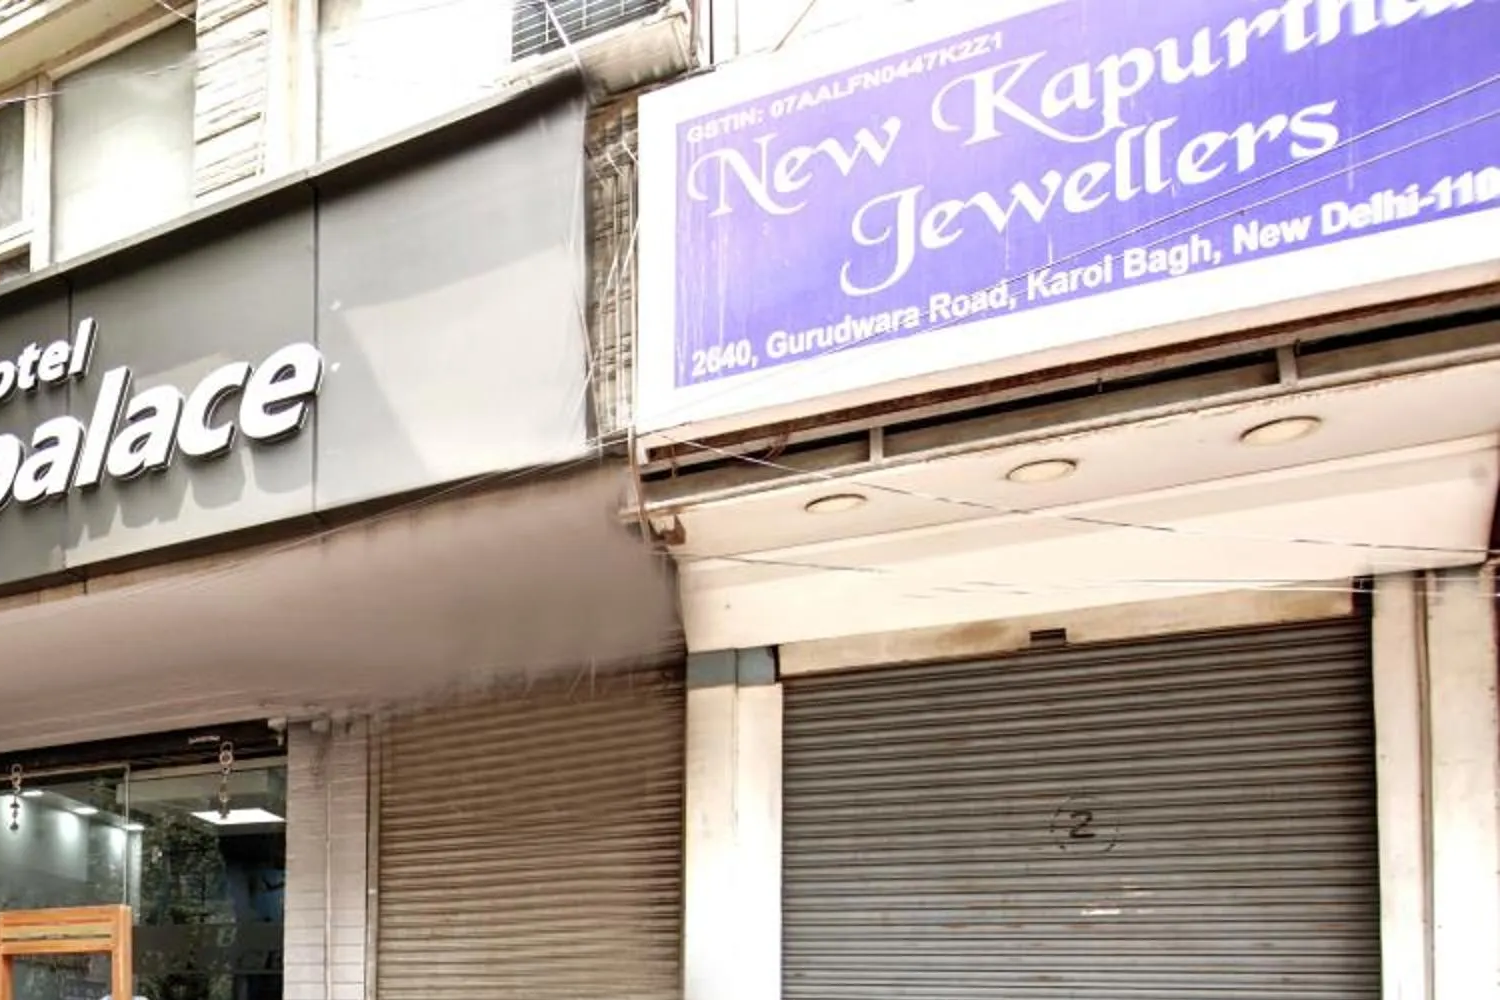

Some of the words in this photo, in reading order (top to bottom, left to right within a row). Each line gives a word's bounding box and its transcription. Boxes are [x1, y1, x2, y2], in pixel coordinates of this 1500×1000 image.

[686, 108, 763, 143] GSTIN:
[686, 115, 901, 217] New
[839, 100, 1339, 297] Jewellers
[691, 338, 758, 377] 2640,
[766, 304, 921, 359] Gurudwara
[928, 281, 1016, 323] Road,
[1123, 235, 1221, 279] Bagh,
[1233, 213, 1312, 255] New
[1069, 809, 1096, 839] 2
